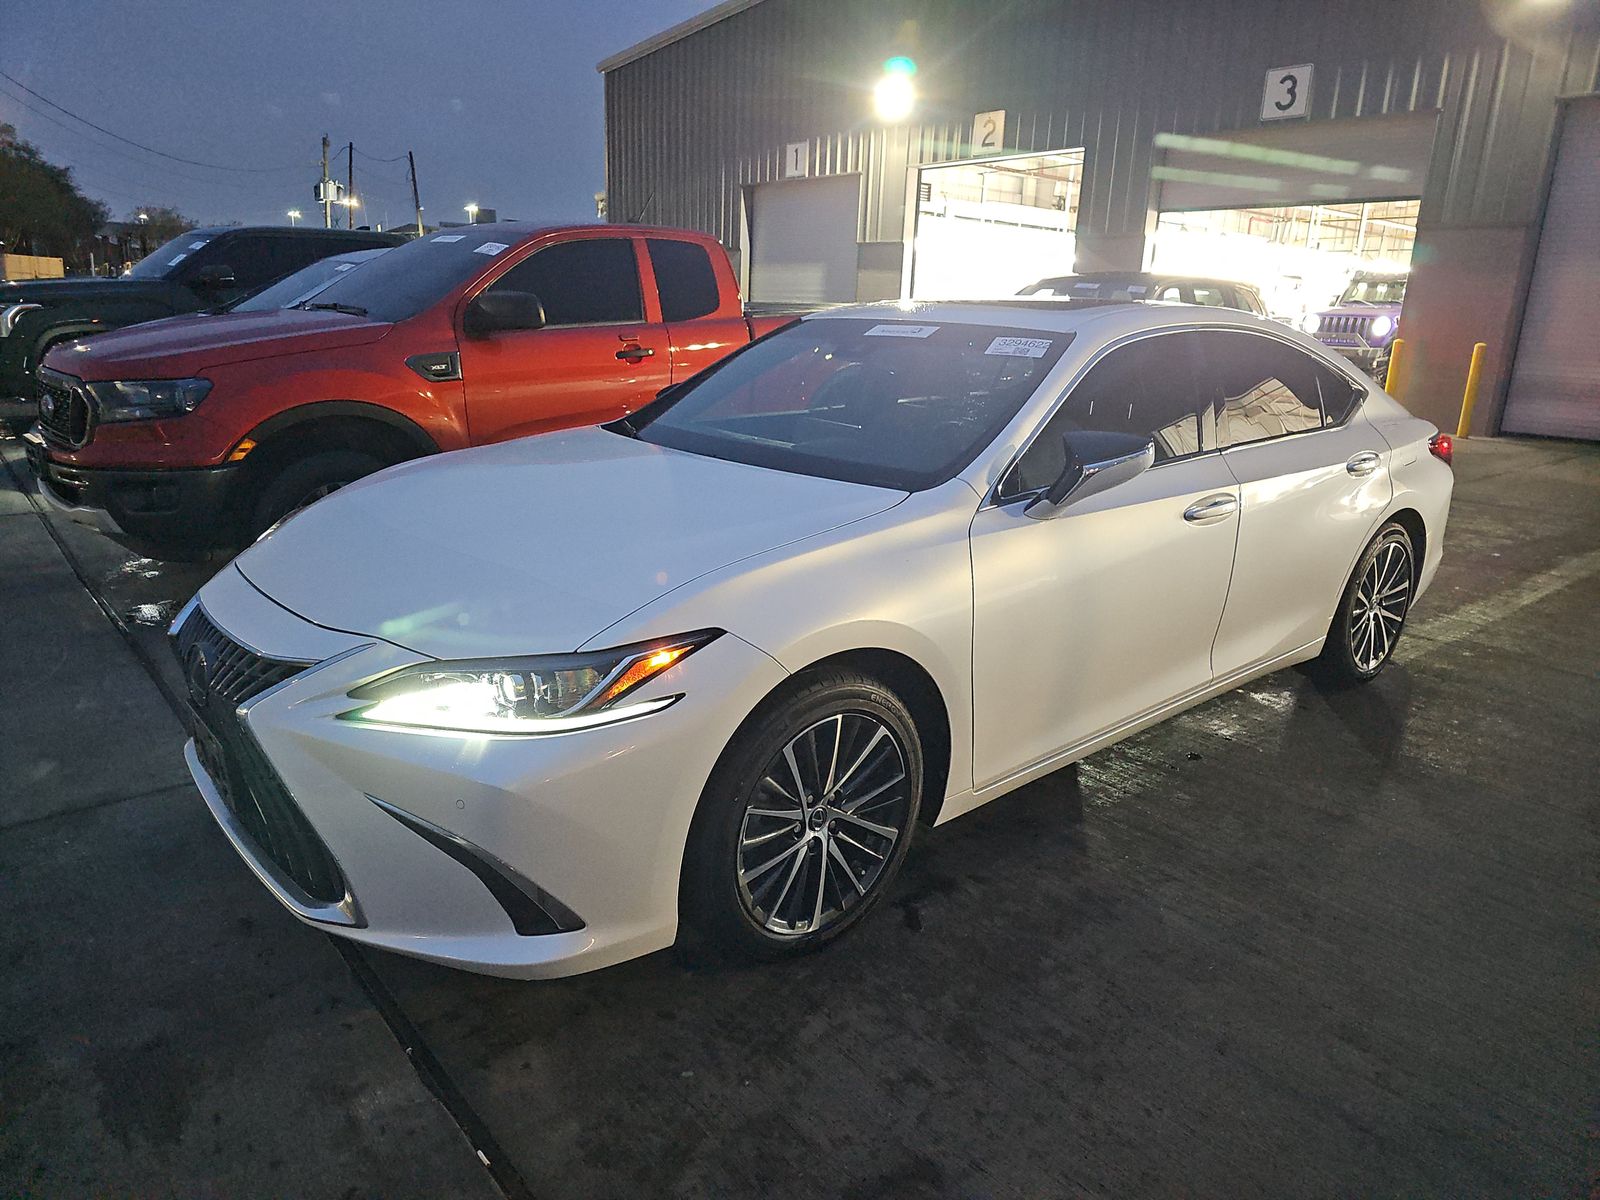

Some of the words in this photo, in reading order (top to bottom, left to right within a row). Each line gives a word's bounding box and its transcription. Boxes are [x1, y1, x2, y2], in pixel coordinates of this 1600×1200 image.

[1274, 74, 1298, 111] 3
[981, 119, 996, 148] 2
[794, 147, 799, 171] 1
